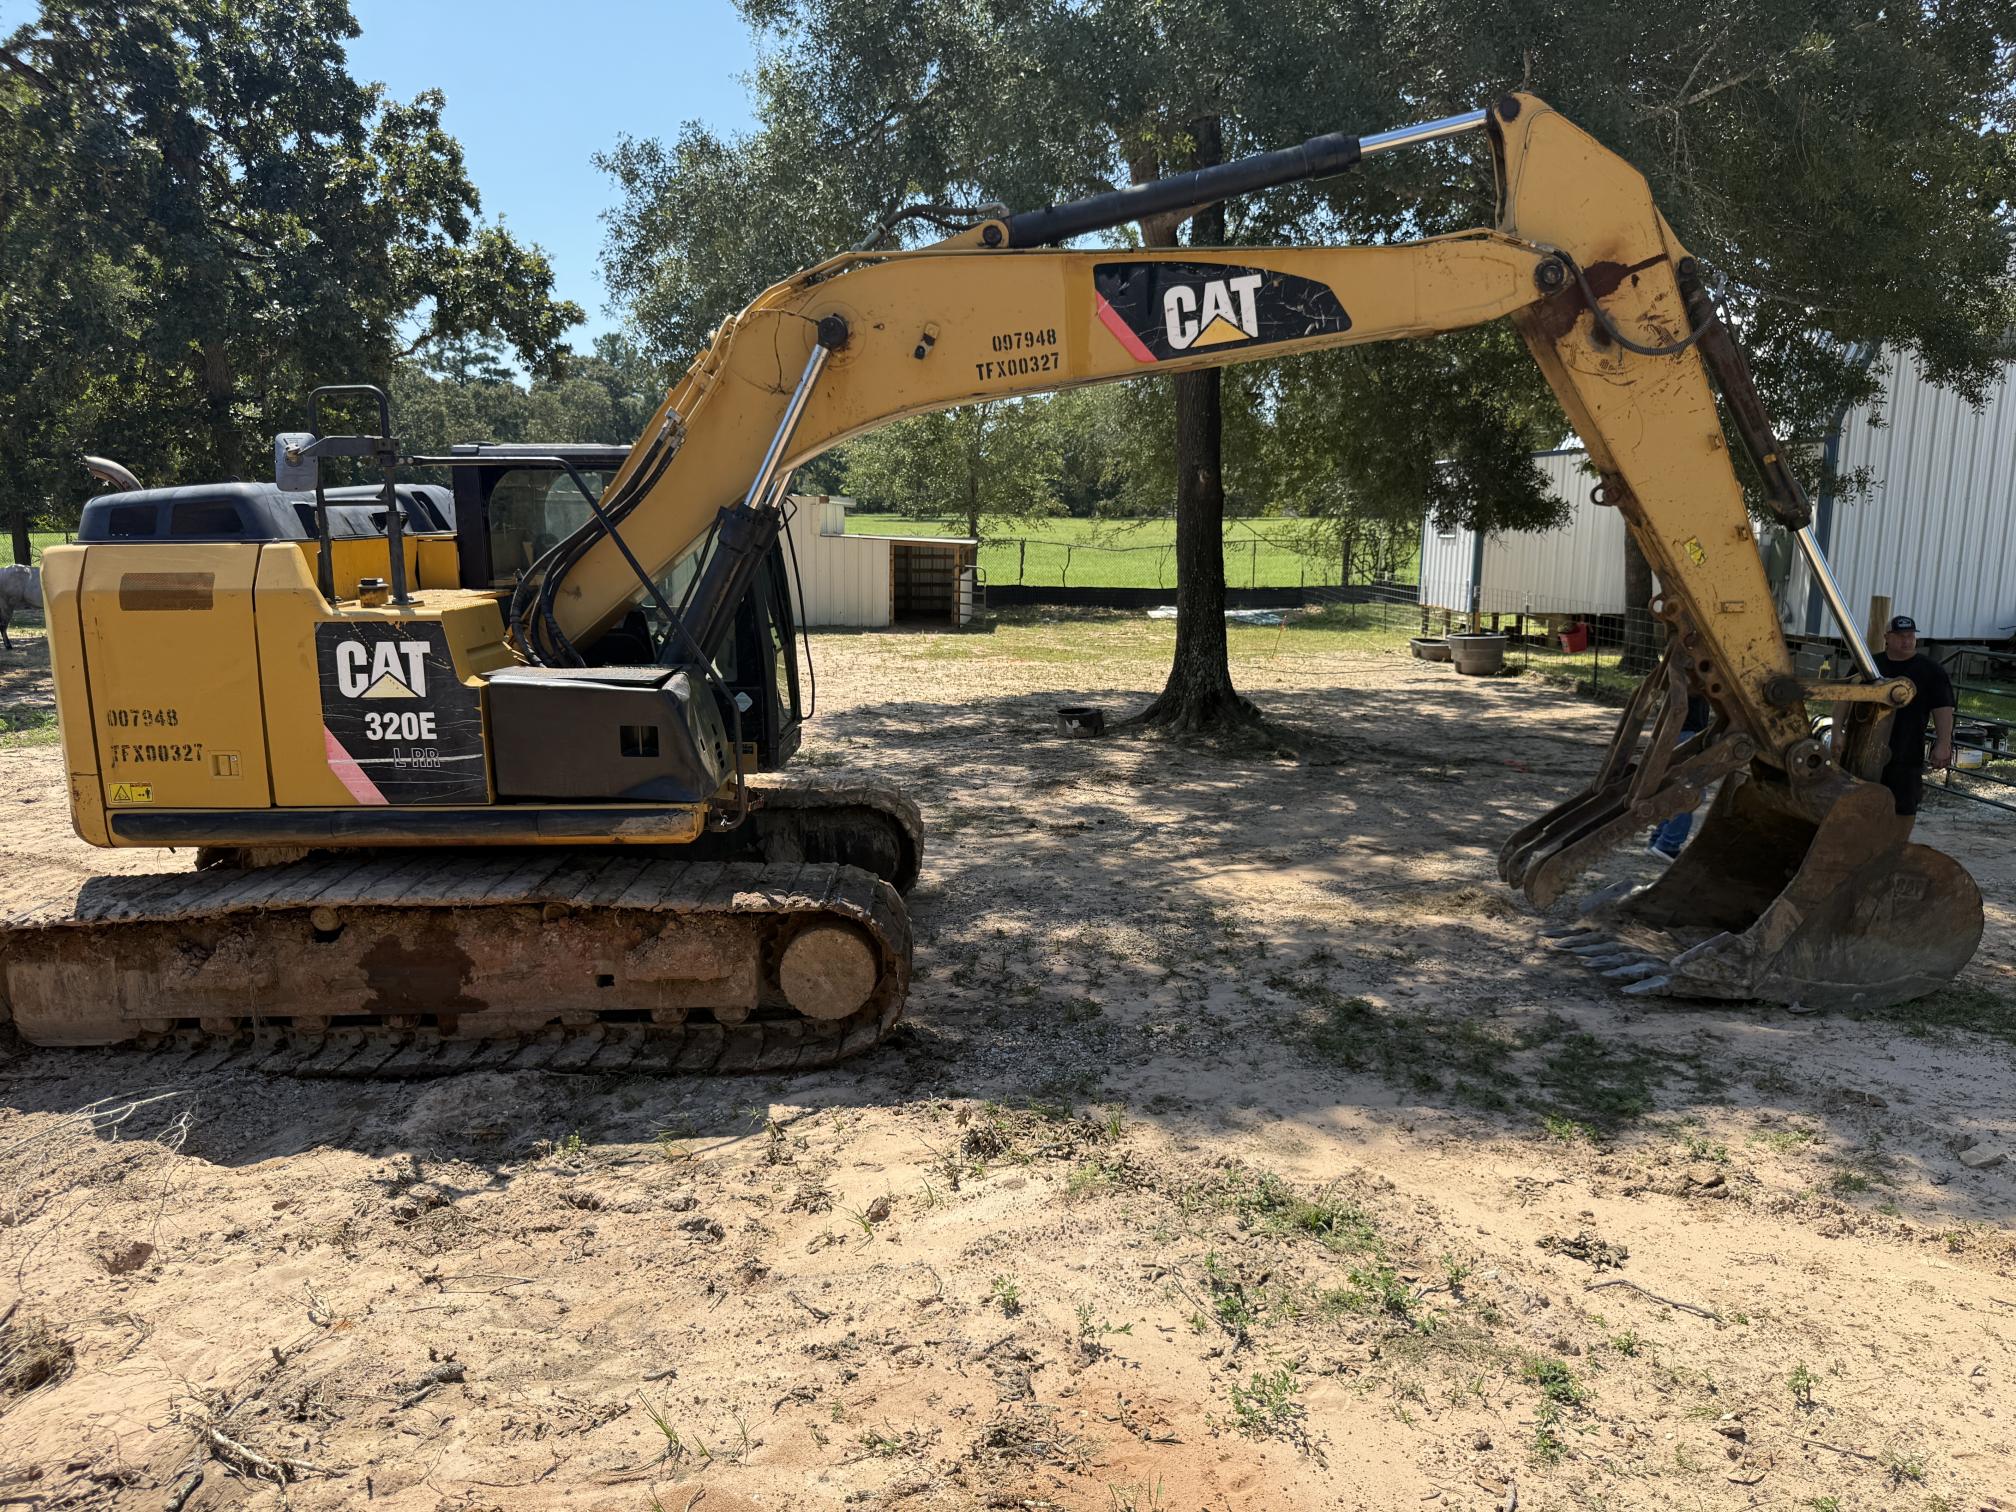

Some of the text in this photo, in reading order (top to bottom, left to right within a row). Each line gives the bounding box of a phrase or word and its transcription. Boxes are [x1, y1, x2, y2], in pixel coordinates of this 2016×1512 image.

[1163, 274, 1262, 350] CAT
[992, 328, 1057, 352] 007948
[975, 352, 1059, 381] TFX00327
[336, 640, 430, 698] CAT
[107, 709, 179, 727] 007948
[364, 711, 438, 741] 320E
[110, 743, 203, 763] TFX00327
[393, 747, 441, 768] L RR
